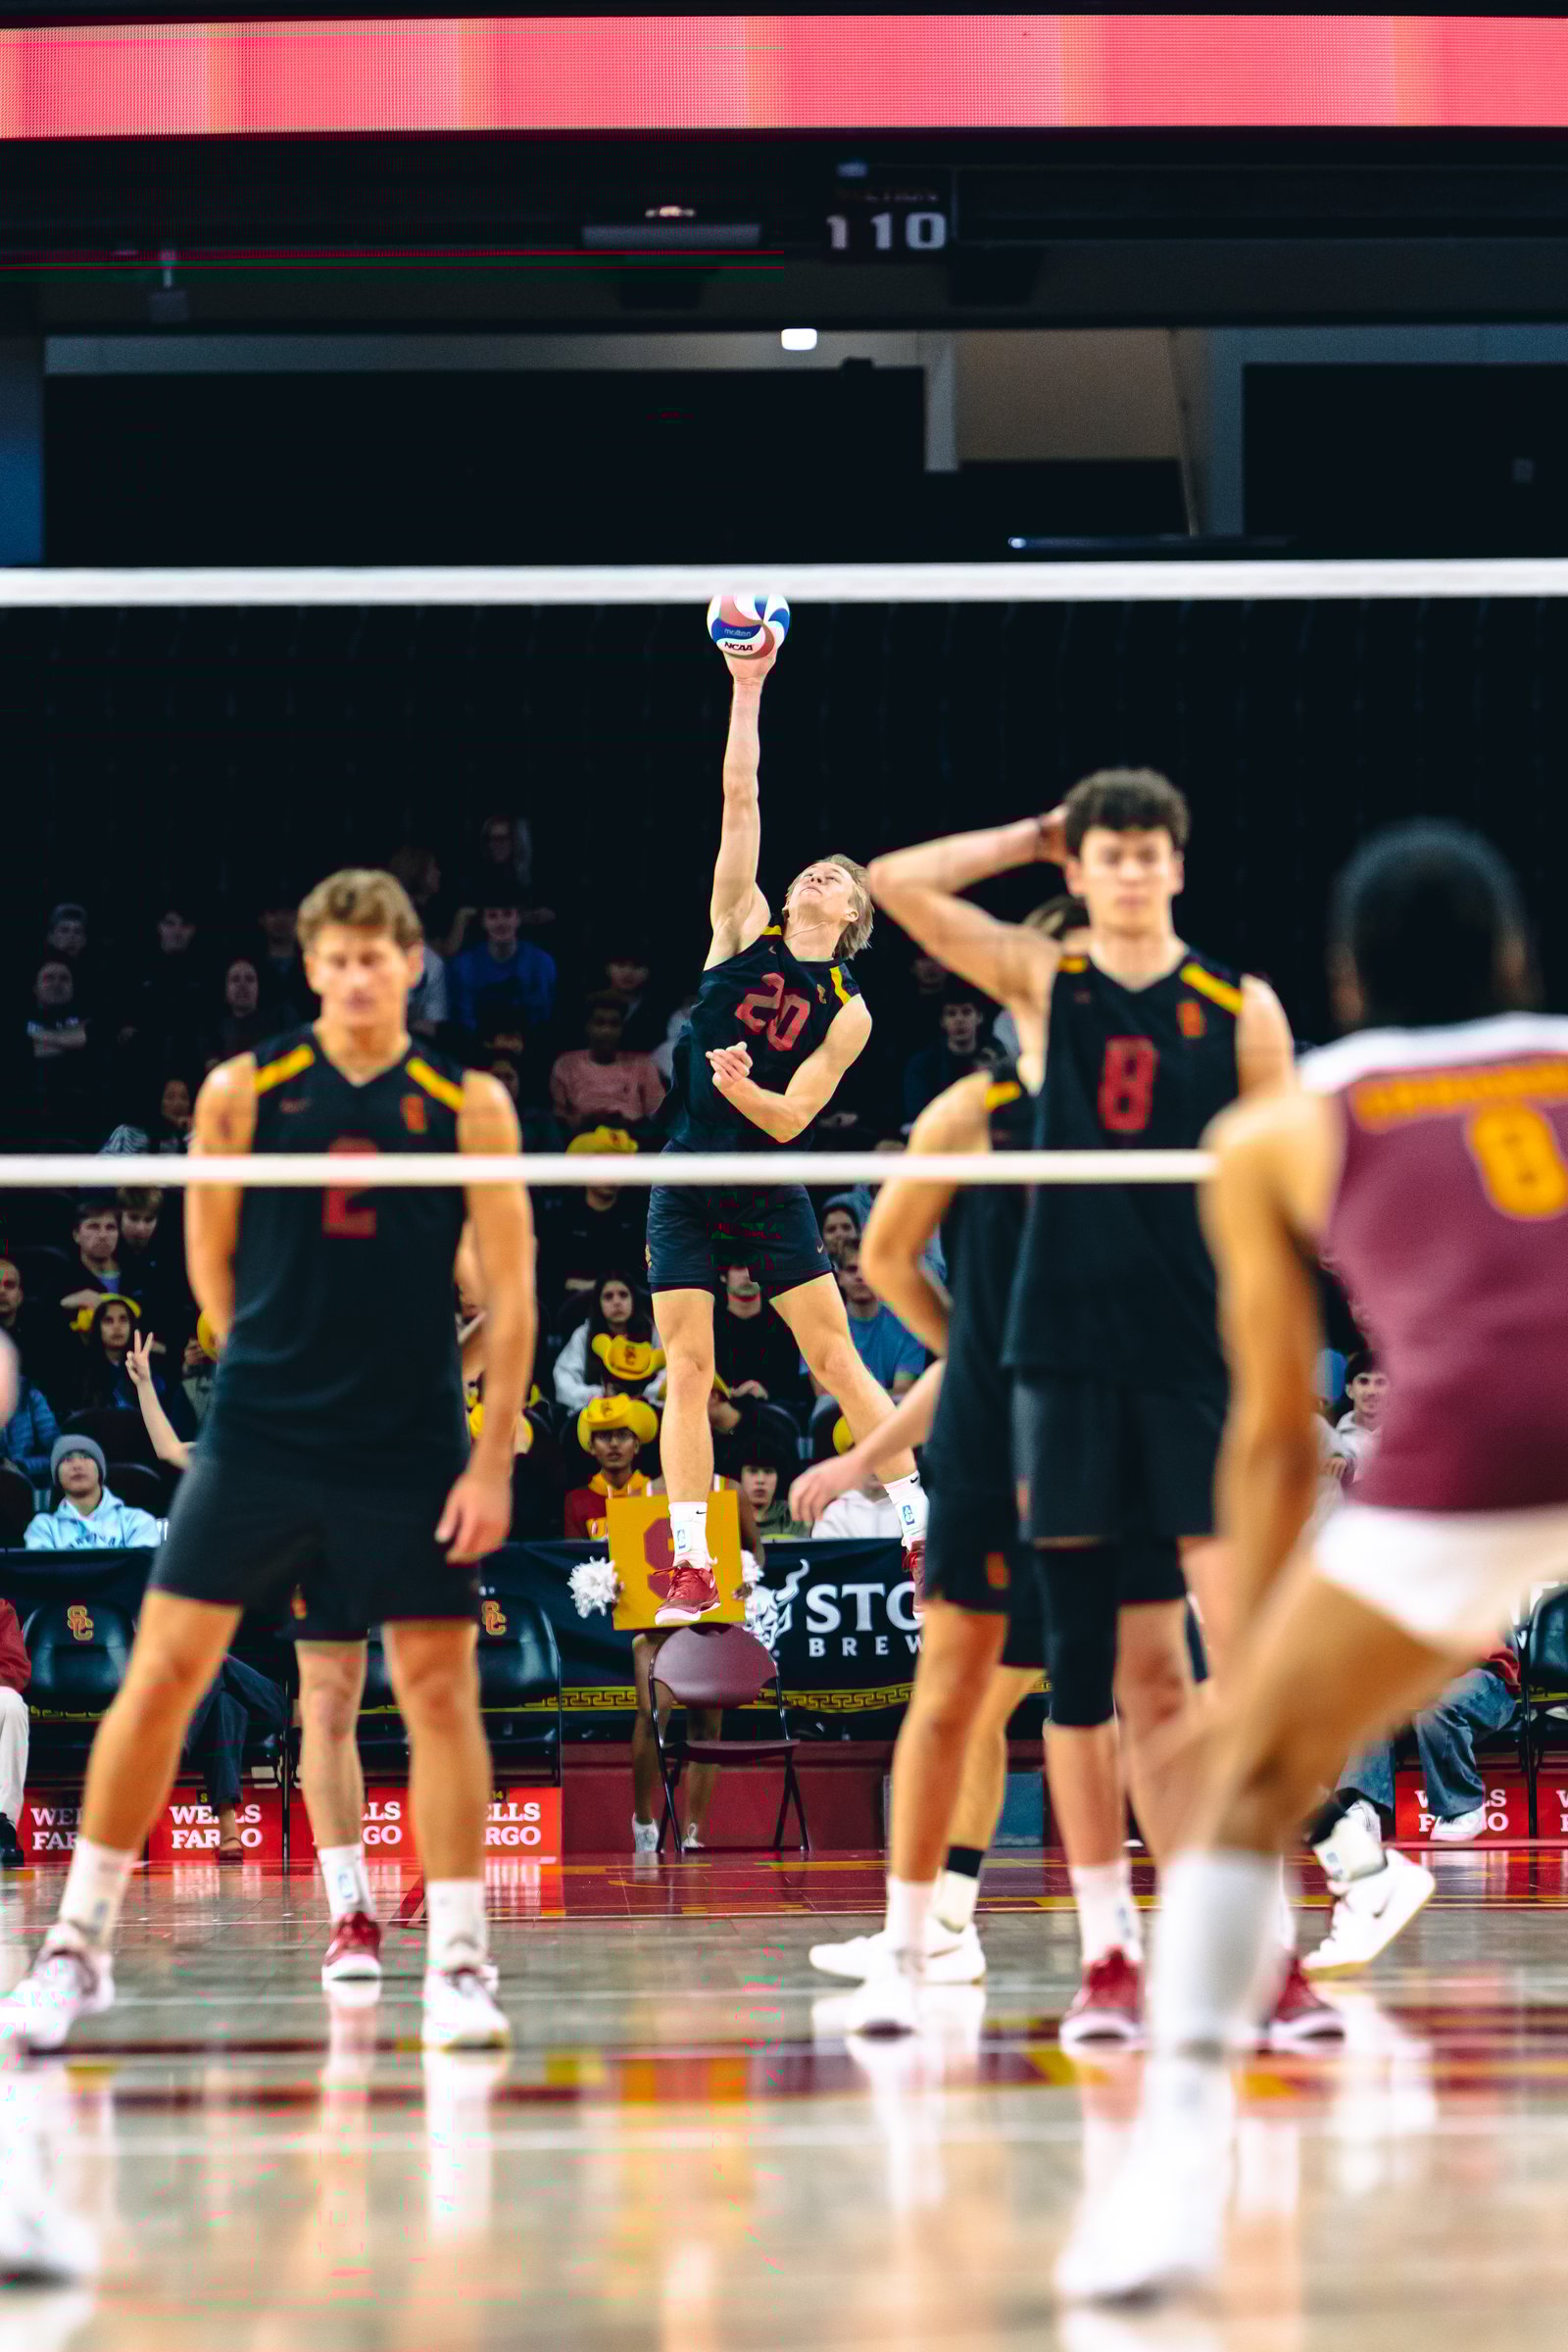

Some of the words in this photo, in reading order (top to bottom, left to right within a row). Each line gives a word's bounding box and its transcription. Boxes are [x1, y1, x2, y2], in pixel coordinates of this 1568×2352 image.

[724, 641, 754, 652] NCAA
[734, 972, 811, 1052] 20
[1101, 1036, 1158, 1133] 8
[324, 1135, 377, 1239] 2
[169, 1804, 262, 1825] WES
[172, 1828, 263, 1849] FARO
